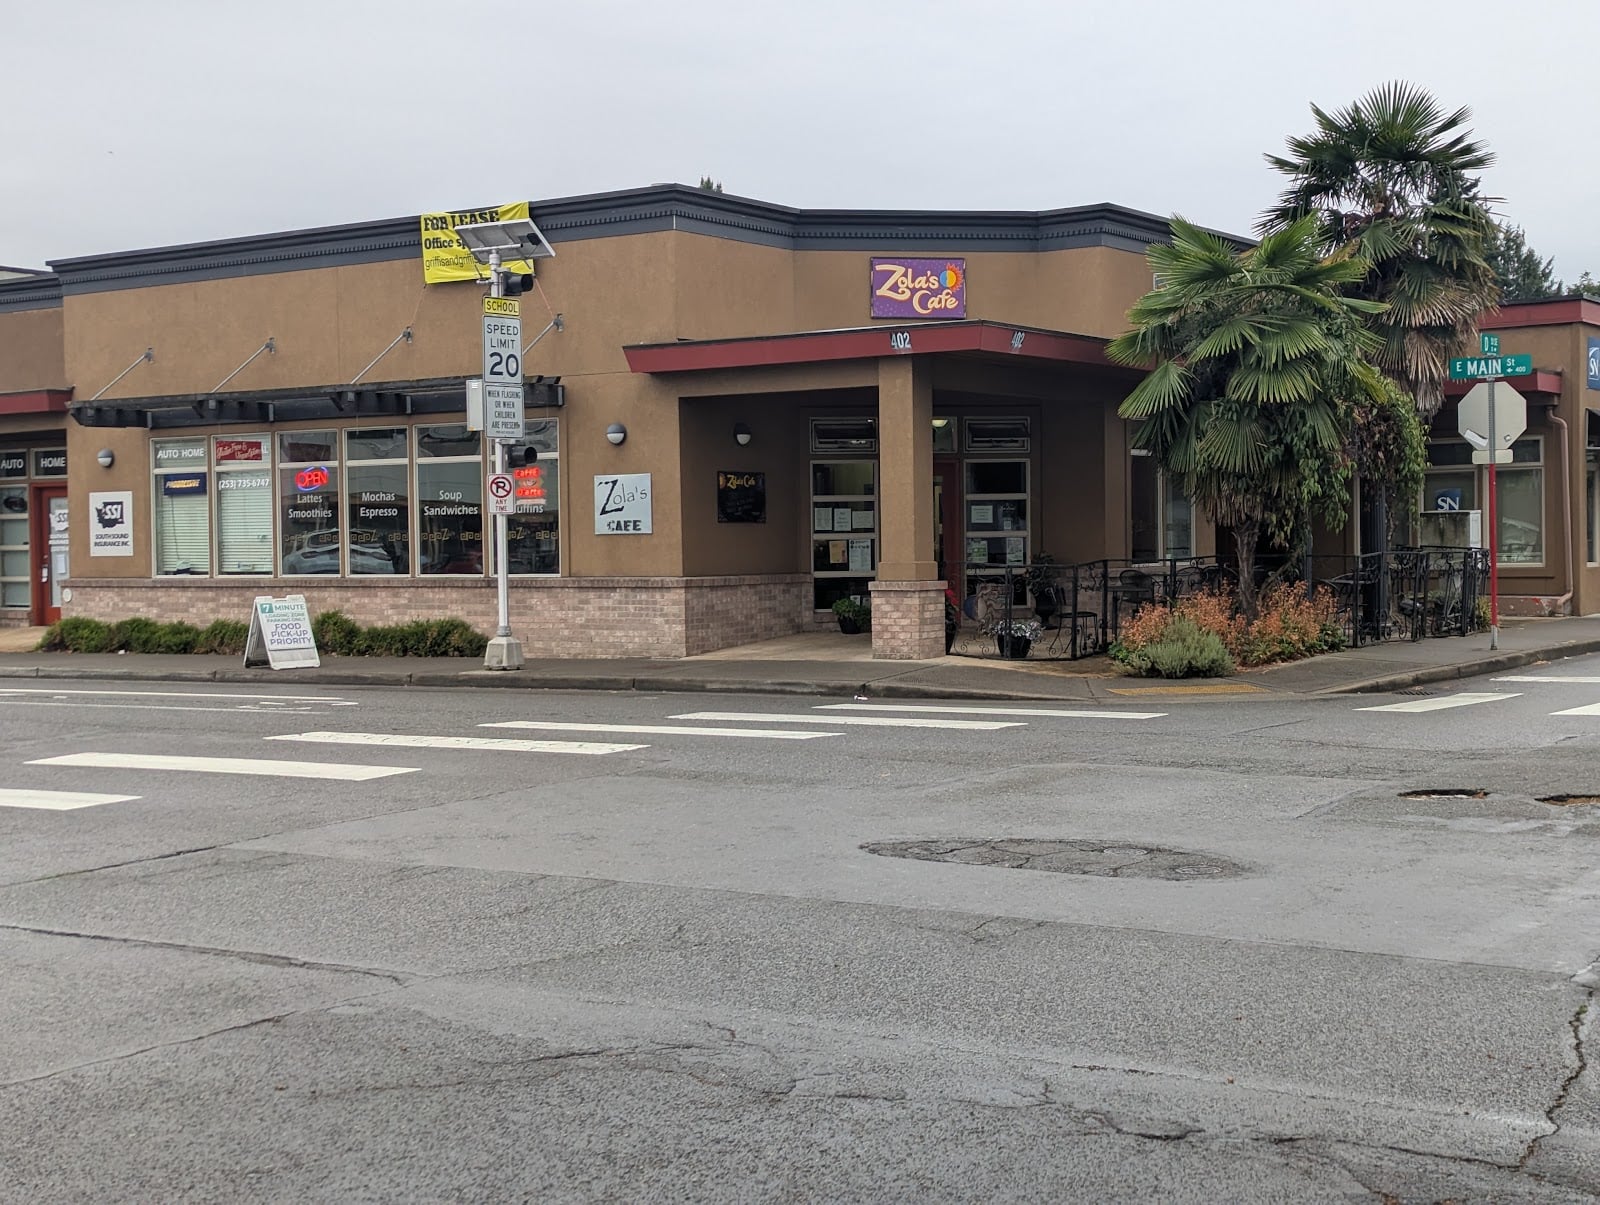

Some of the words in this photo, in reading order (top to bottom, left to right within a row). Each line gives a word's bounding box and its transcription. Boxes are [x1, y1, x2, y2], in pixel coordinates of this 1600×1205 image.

[423, 216, 449, 231] FOR
[451, 210, 499, 225] LEASE
[424, 237, 453, 249] Office
[875, 264, 940, 301] Zola's
[486, 300, 518, 313] SCHOOL
[912, 289, 959, 315] Cafe
[486, 323, 519, 336] SPEED
[490, 337, 515, 349] LIMIT
[891, 332, 912, 349] 402
[1011, 331, 1025, 349] 402
[489, 351, 519, 378] 20
[1456, 361, 1463, 372] E
[1467, 359, 1502, 375] MAIN
[1506, 358, 1516, 366] St
[487, 390, 500, 398] WHEN
[501, 391, 521, 399] FLASHING
[502, 401, 515, 409] WHEN
[494, 411, 515, 419] CHILDREN
[491, 421, 500, 429] ARE
[157, 450, 179, 459] AUTO
[181, 448, 205, 458] HOME
[1, 459, 24, 469] AUTO
[40, 457, 66, 468] HOME
[238, 478, 270, 488] 735-6747
[296, 470, 328, 487] OPEN
[297, 494, 323, 503] Lattes
[361, 491, 396, 502] Mochas
[439, 490, 463, 502] Soup
[597, 478, 649, 516] Zola's
[1437, 496, 1459, 511] SN
[104, 504, 121, 519] SSI
[288, 507, 333, 519] Smoothies
[360, 506, 398, 519] Espresso
[423, 504, 479, 516] Sandwiches
[606, 519, 642, 532] CAFE
[263, 604, 270, 612] 7
[274, 603, 305, 611] MINUTE
[275, 623, 302, 631] FOOD
[271, 630, 309, 638] PICK-UP
[270, 637, 312, 646] PRIORITY
